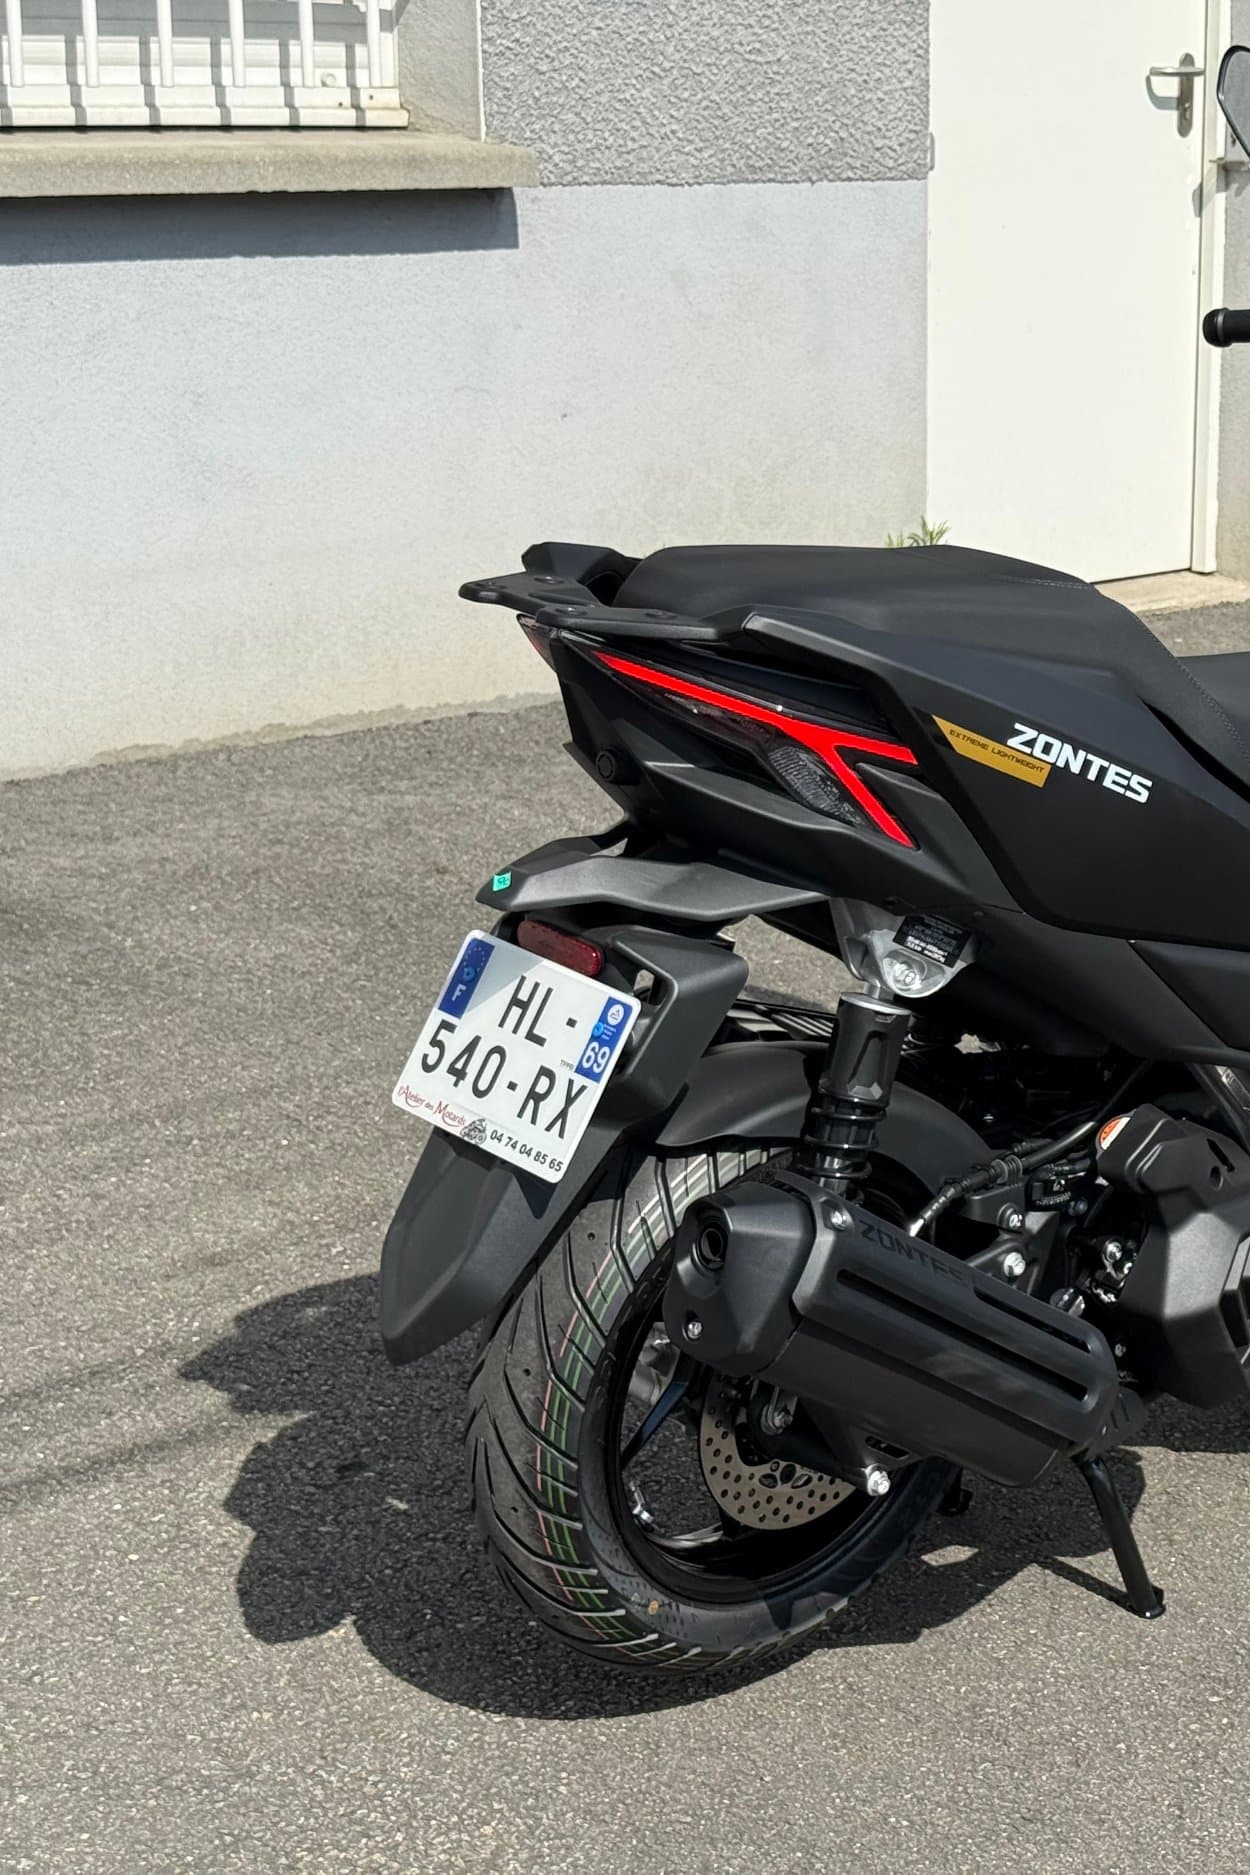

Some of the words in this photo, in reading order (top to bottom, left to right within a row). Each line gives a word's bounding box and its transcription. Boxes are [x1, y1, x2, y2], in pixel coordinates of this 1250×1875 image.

[949, 729, 990, 751] EXTREME
[991, 747, 1045, 774] LIGHTWEIGHT
[1006, 722, 1153, 804] ZONTES
[452, 984, 467, 1001] F
[582, 1041, 610, 1073] 69
[421, 1020, 588, 1140] 540-RX
[489, 1129, 505, 1144] 04
[505, 1136, 519, 1151] 74
[519, 1143, 533, 1158] 04
[533, 1150, 547, 1165] 85
[548, 1157, 564, 1173] 65
